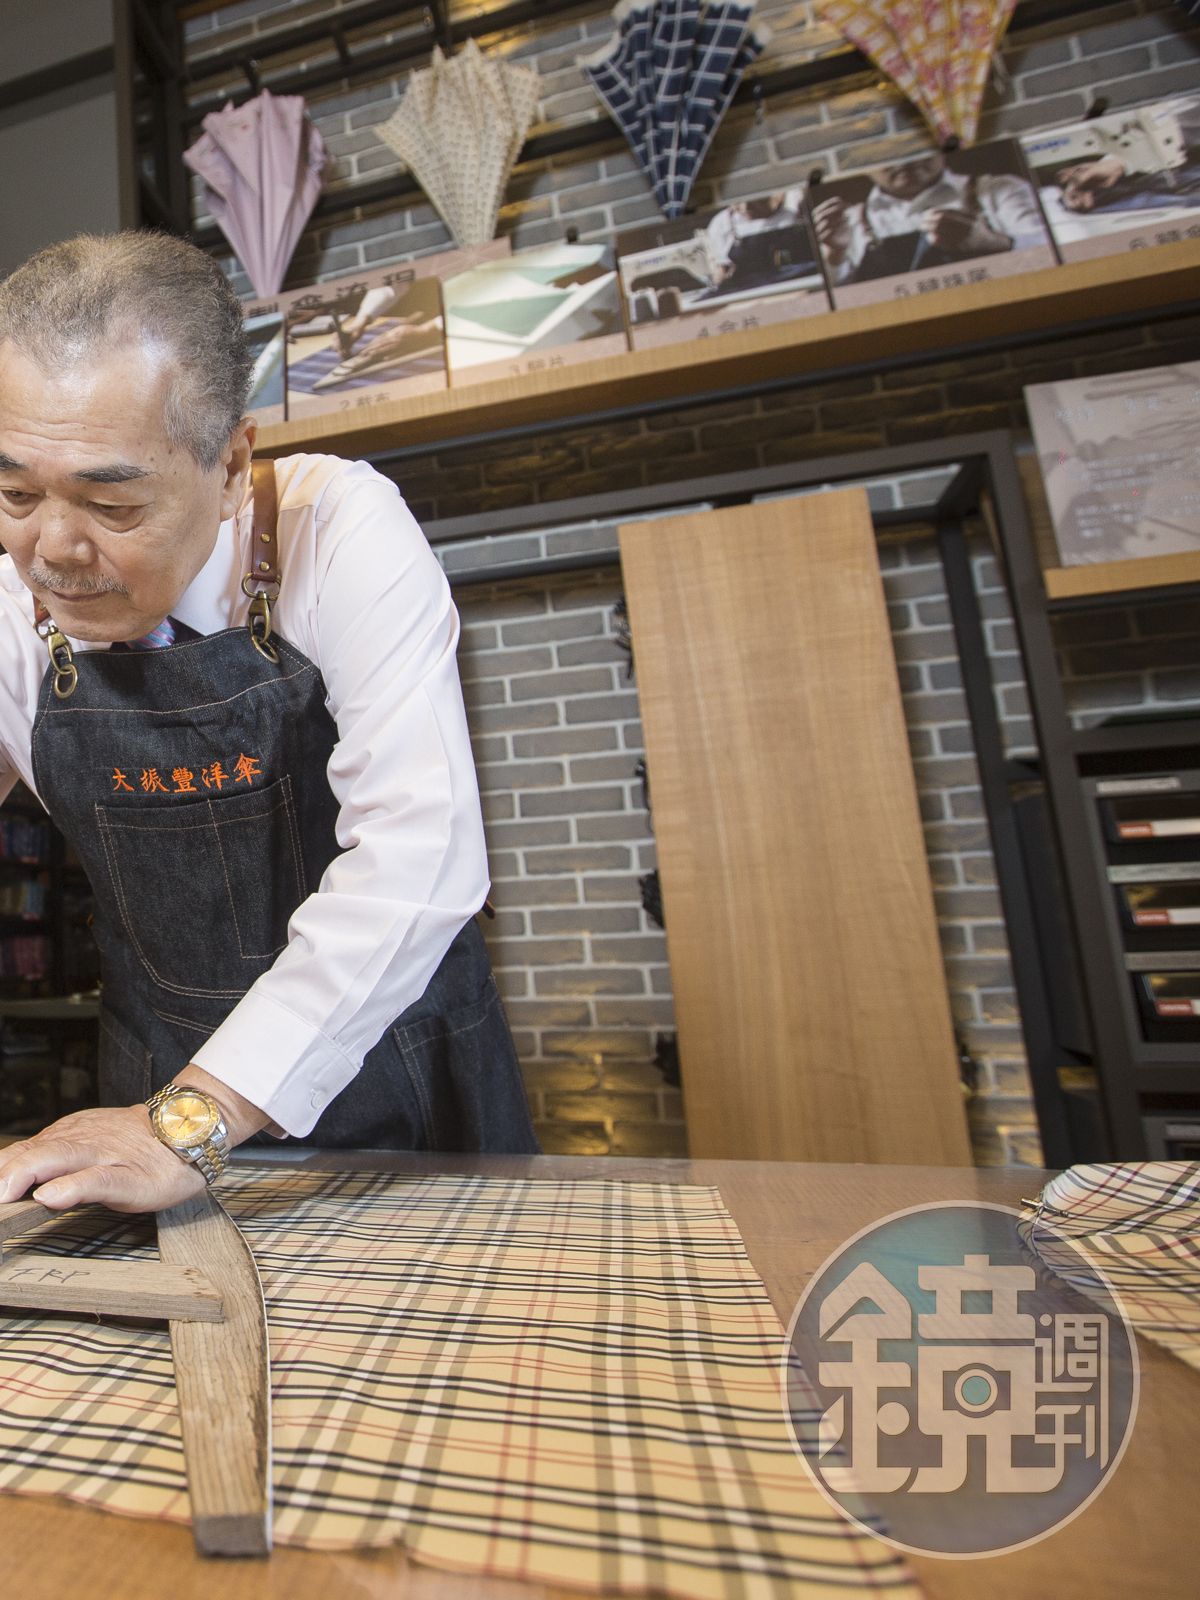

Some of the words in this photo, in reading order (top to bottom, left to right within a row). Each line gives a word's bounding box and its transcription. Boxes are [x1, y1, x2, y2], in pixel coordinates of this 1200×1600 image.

[111, 752, 264, 793] 大振豐洋傘
